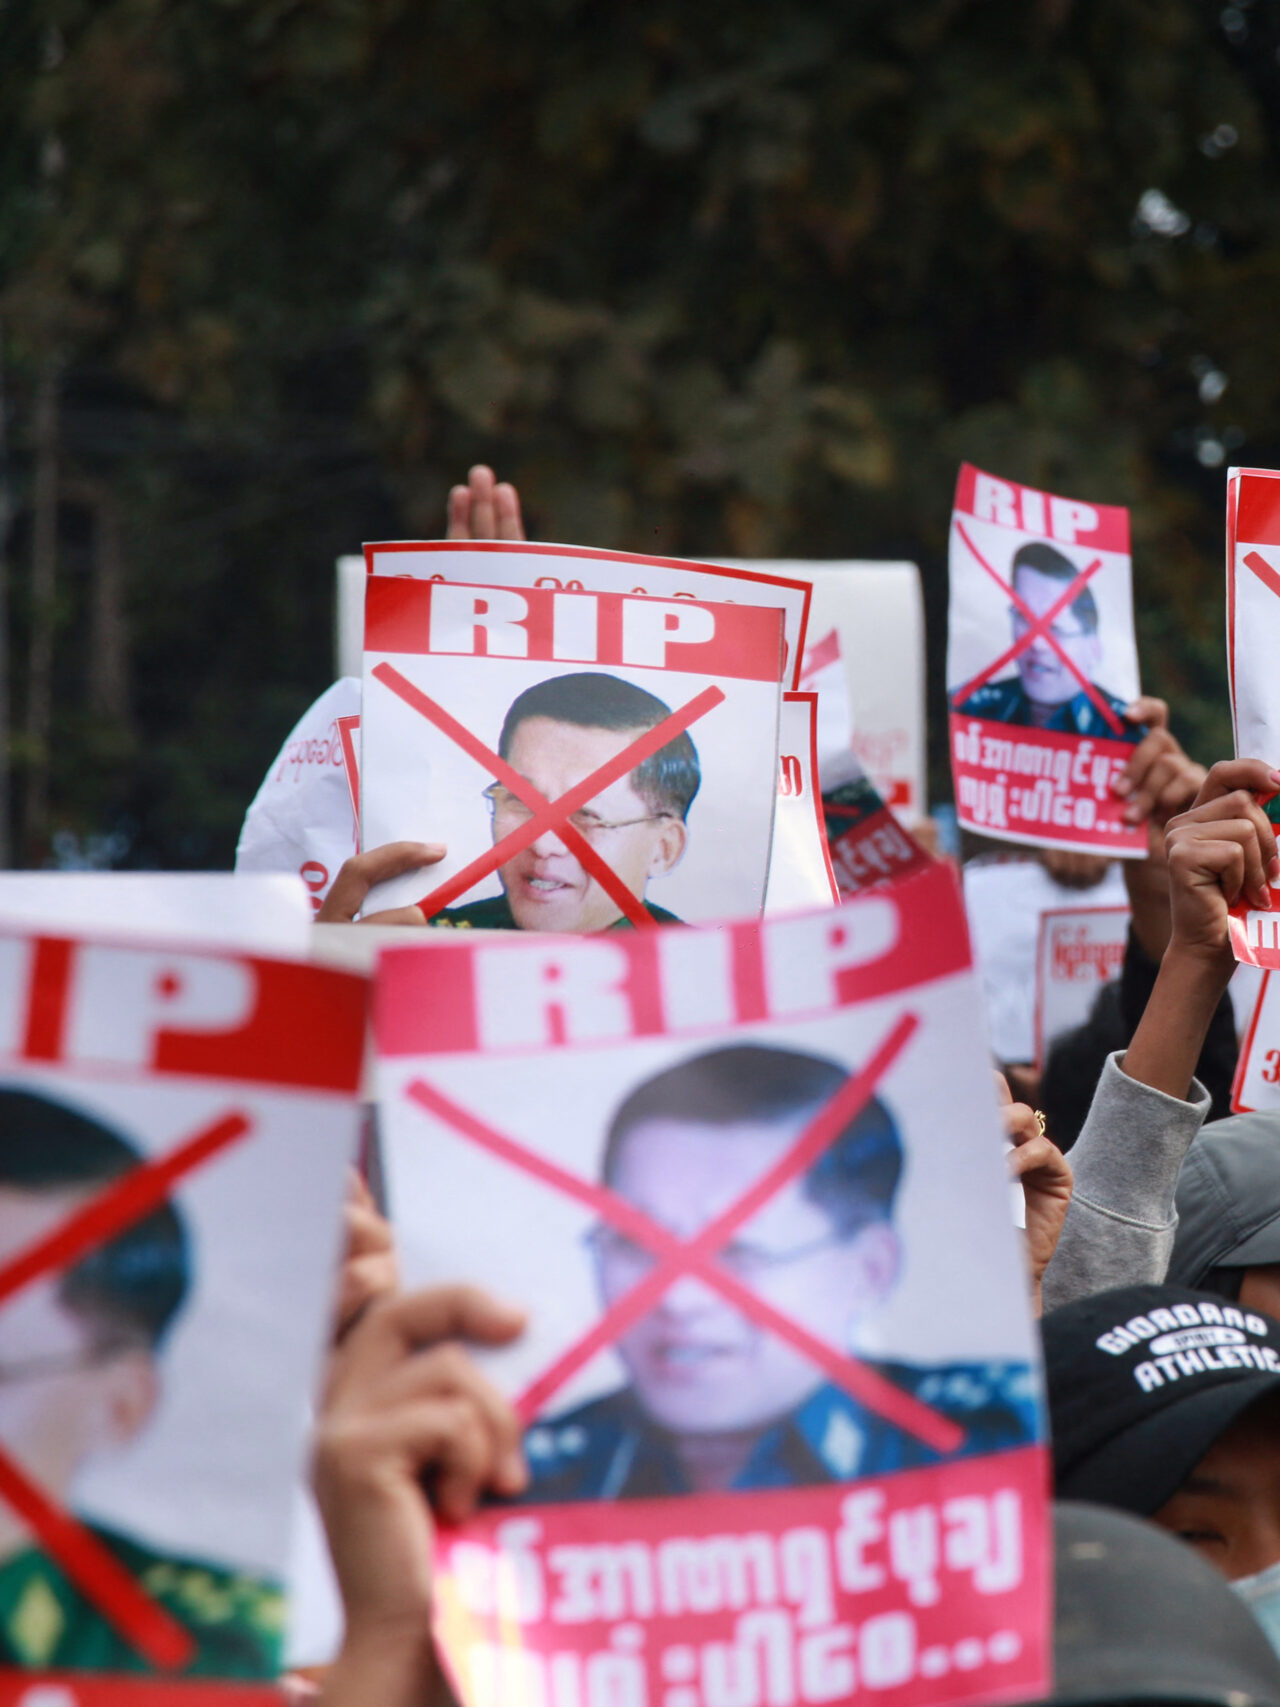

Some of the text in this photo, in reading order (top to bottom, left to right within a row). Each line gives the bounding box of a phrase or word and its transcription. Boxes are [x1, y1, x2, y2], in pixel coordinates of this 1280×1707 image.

[973, 472, 1099, 545] RIP
[429, 583, 716, 669] RIP
[473, 897, 899, 1048] RIP
[1096, 1302, 1269, 1356] GIORDANO
